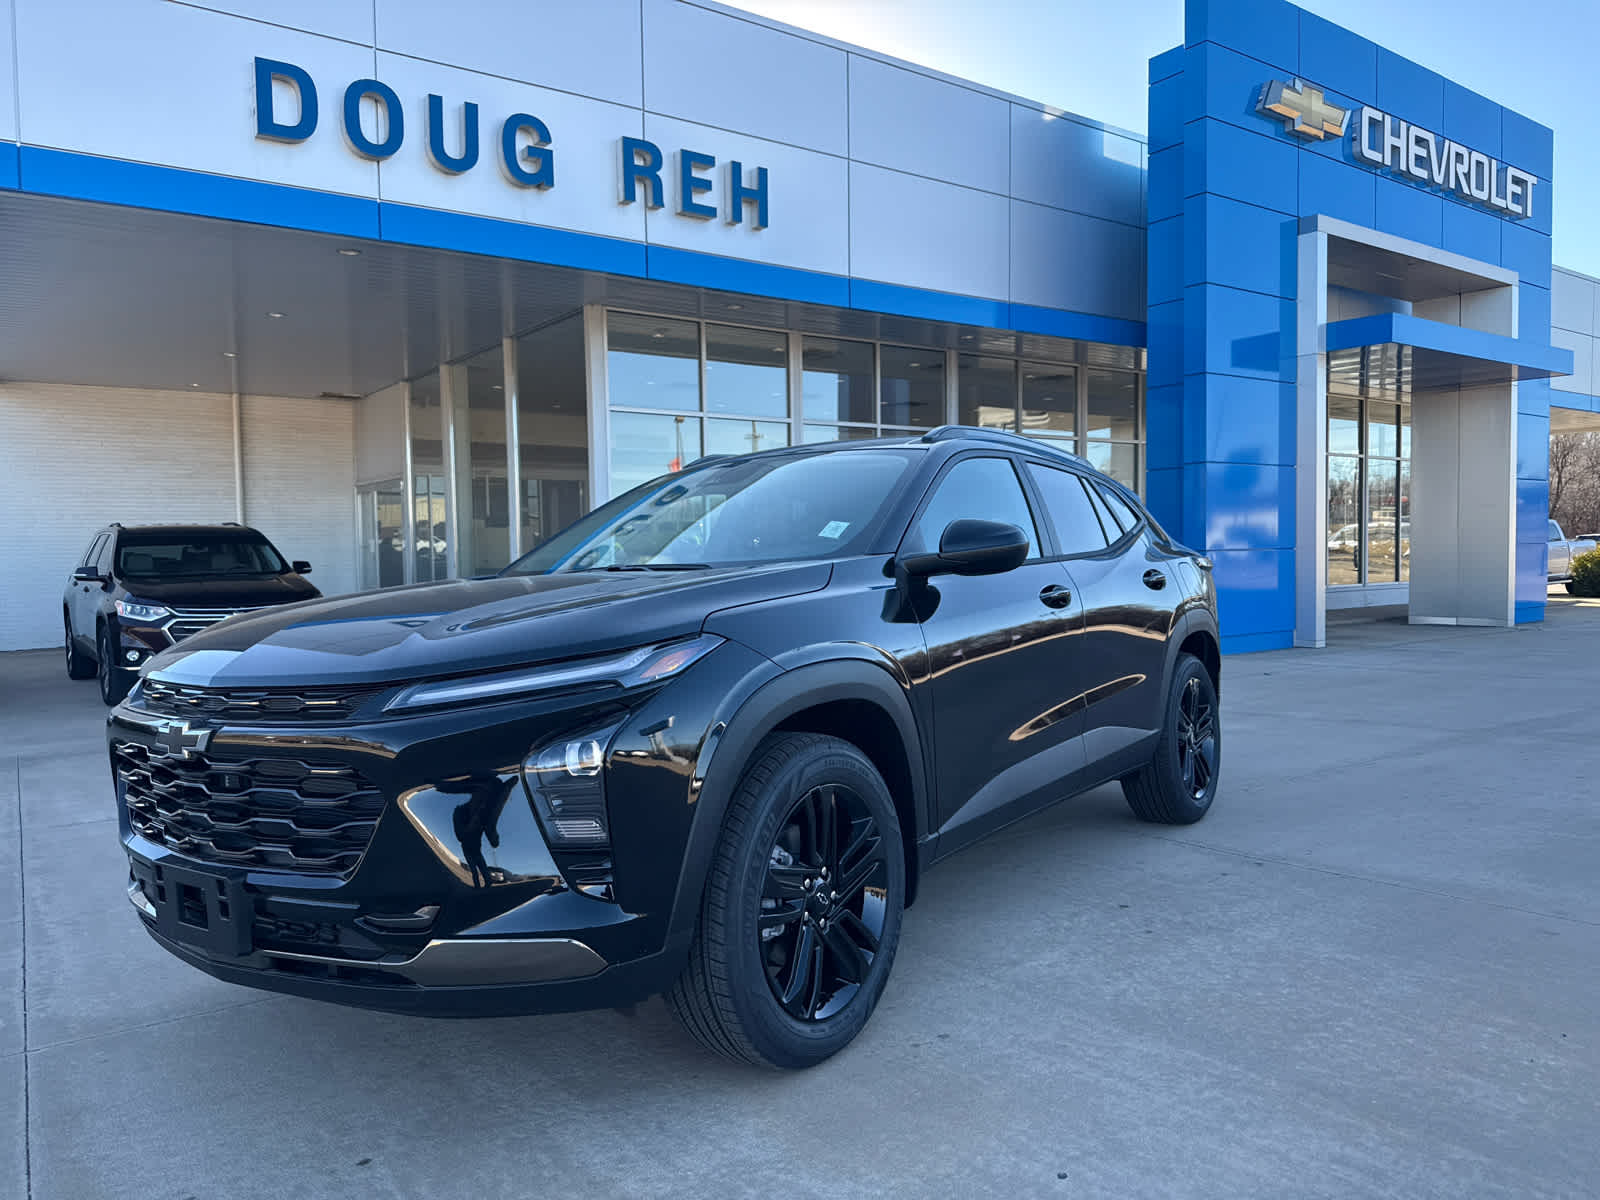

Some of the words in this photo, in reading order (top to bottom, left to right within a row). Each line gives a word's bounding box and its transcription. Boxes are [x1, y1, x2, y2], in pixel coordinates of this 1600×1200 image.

[254, 56, 554, 190] DOUG
[618, 135, 769, 230] REH
[1356, 104, 1538, 218] CHEVROLET
